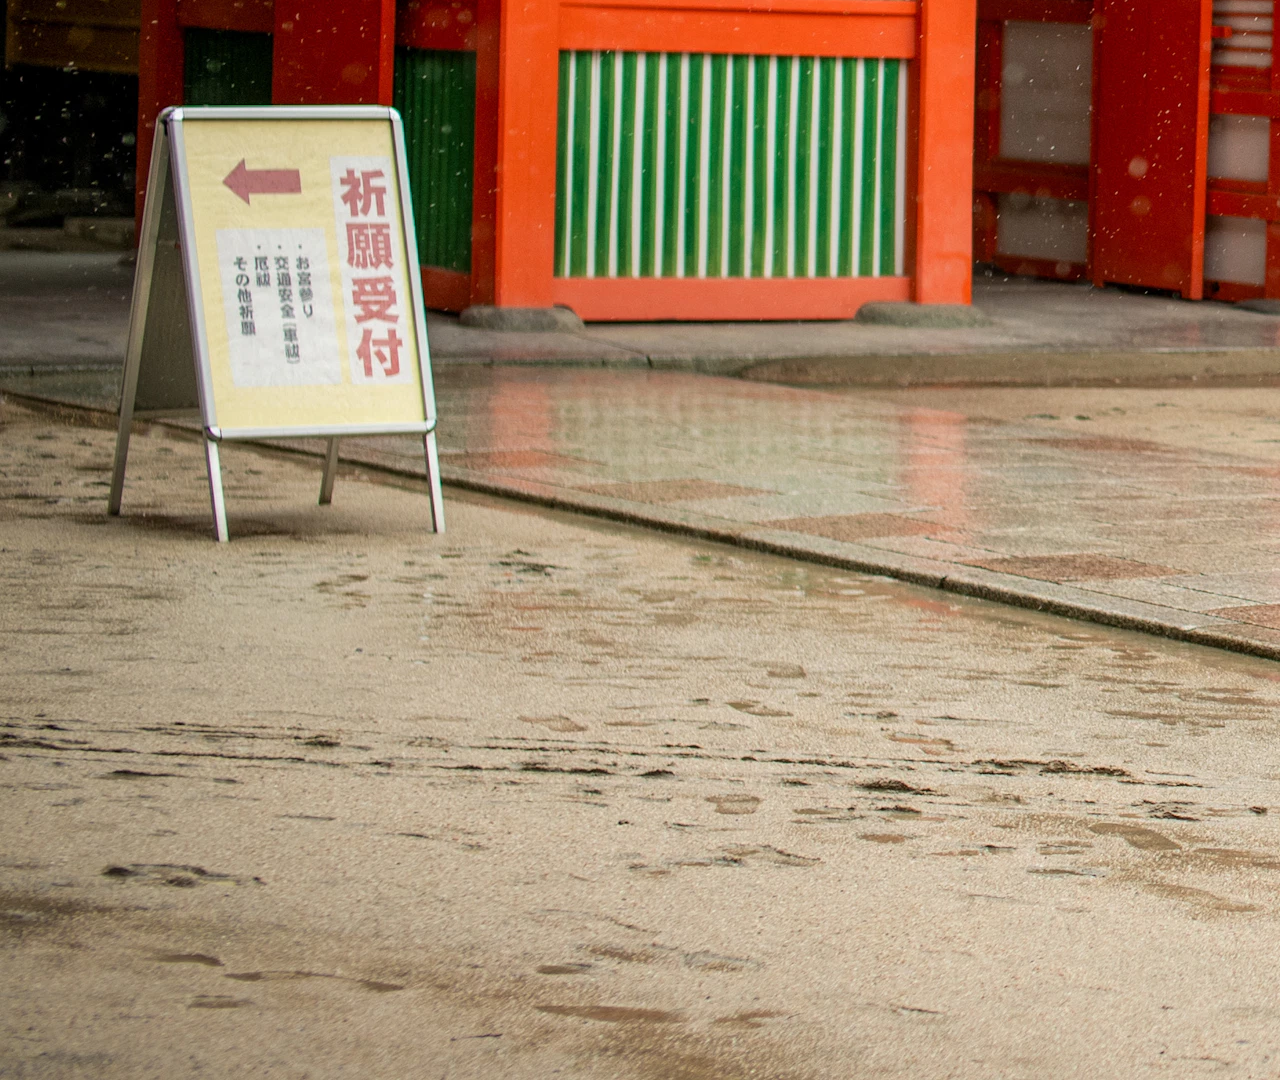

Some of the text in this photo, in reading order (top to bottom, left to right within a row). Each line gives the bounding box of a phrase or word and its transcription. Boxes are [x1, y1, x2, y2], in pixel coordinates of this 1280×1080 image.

[233, 256, 256, 336] その他祈願
[340, 168, 403, 377] 祈願受付
